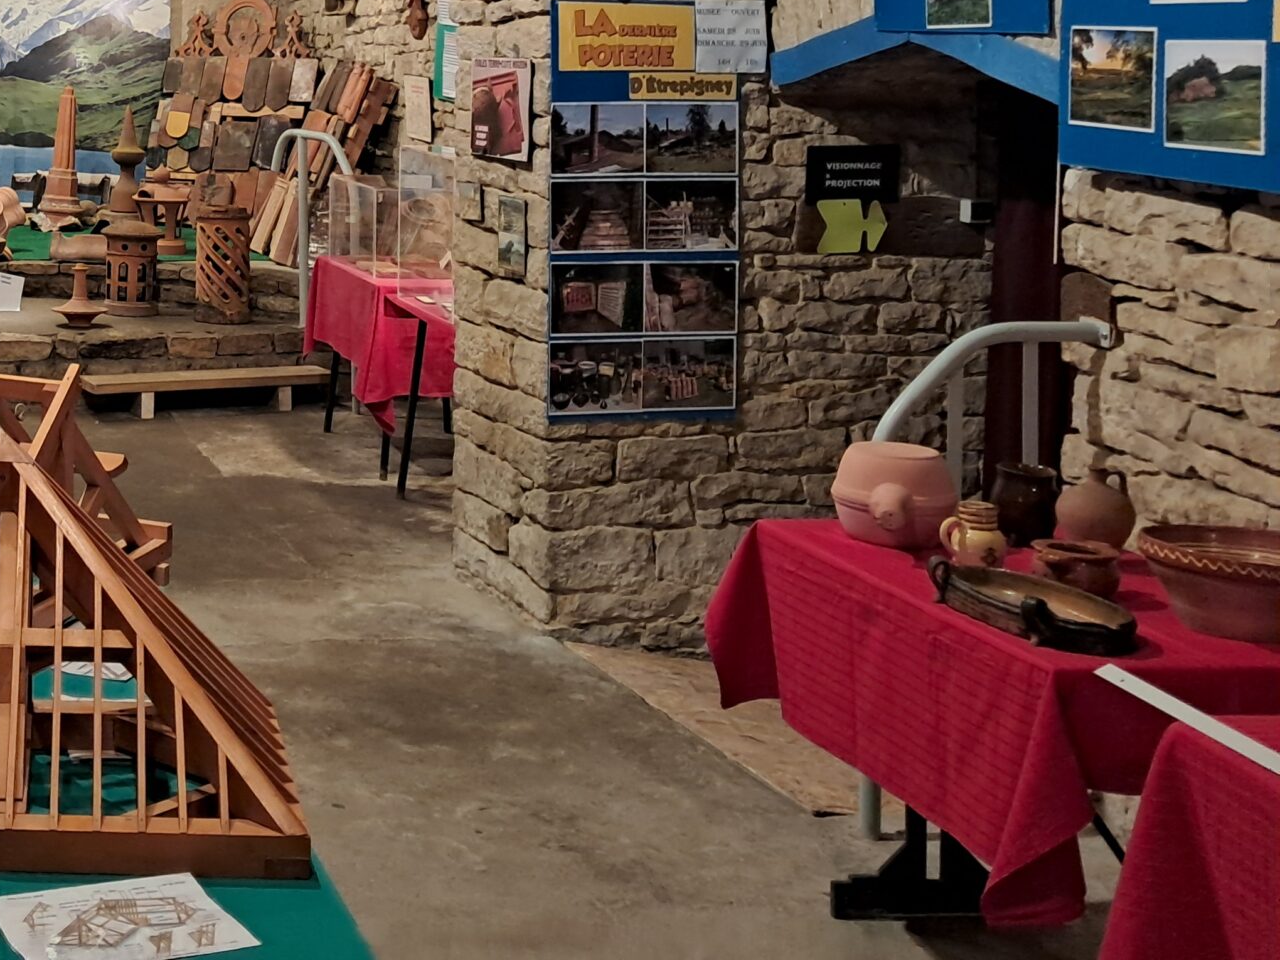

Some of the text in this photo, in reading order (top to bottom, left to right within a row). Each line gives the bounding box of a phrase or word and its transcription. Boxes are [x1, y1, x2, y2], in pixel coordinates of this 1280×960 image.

[575, 8, 677, 38] LA DERNIÈRE
[578, 43, 675, 68] POTERIE
[826, 162, 883, 170] VISIONNAGE
[825, 179, 881, 189] PROJECTION
